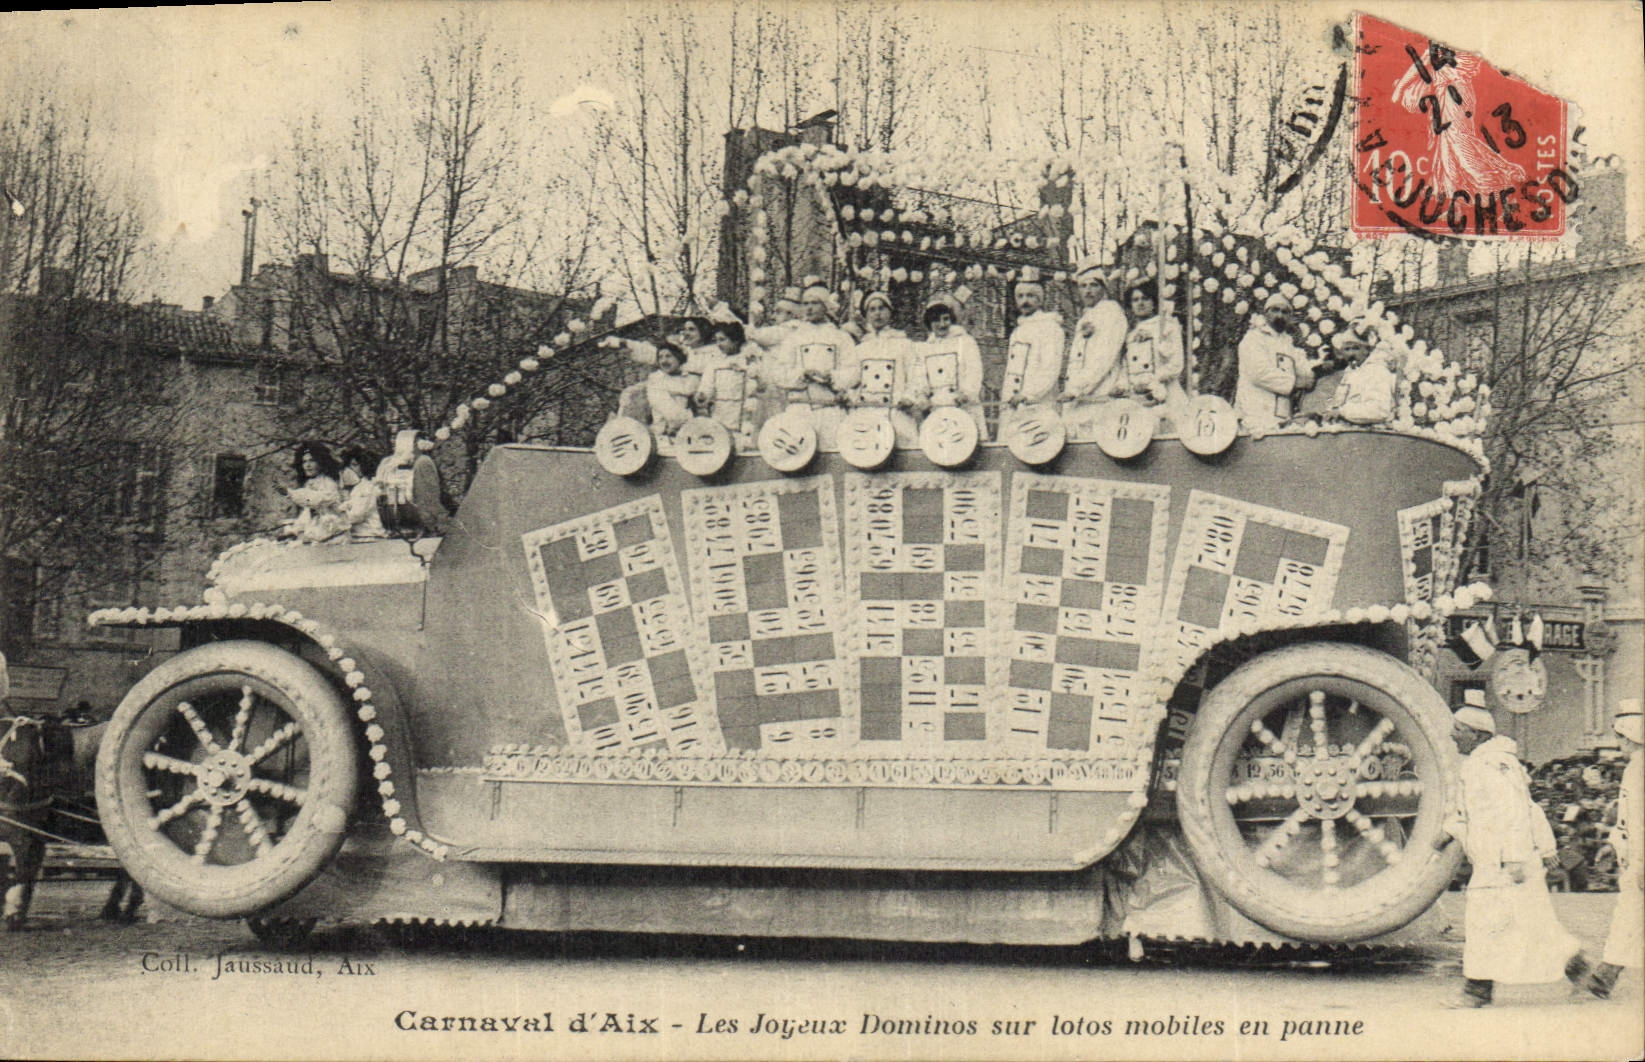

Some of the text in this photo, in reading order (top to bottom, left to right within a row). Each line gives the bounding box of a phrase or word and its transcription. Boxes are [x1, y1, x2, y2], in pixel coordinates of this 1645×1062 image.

[1118, 413, 1130, 441] 8
[741, 495, 771, 524] 85
[866, 488, 893, 513] 86
[951, 487, 977, 515] 90
[1075, 498, 1104, 522] 87
[703, 504, 730, 529] 82
[866, 516, 895, 541] 70
[1205, 515, 1235, 543] 80
[705, 534, 735, 556] 74
[746, 526, 776, 551] 79
[624, 543, 655, 571] 76
[789, 550, 817, 575] 65
[867, 546, 896, 570] 62
[911, 546, 935, 570] 69
[1196, 541, 1231, 567] 72
[708, 562, 736, 584] 61
[1070, 555, 1099, 579] 64
[595, 584, 621, 608] 69
[1109, 583, 1138, 610] 58
[1234, 579, 1263, 606] 65
[1277, 562, 1314, 616] 67 78
[755, 607, 783, 634] 40
[796, 608, 826, 630] 42
[866, 605, 895, 624] 41
[908, 602, 936, 624] 48
[1012, 692, 1043, 713] 12
[1029, 523, 1059, 544] 71
[1104, 616, 1135, 637] 47
[569, 649, 599, 672] 41
[760, 670, 790, 695] 21
[1101, 673, 1131, 697] 24
[623, 691, 652, 716] 20
[907, 690, 936, 705] 11
[949, 688, 979, 707] 17
[668, 706, 697, 731] 16
[767, 730, 793, 743] 6
[809, 727, 836, 739] 8
